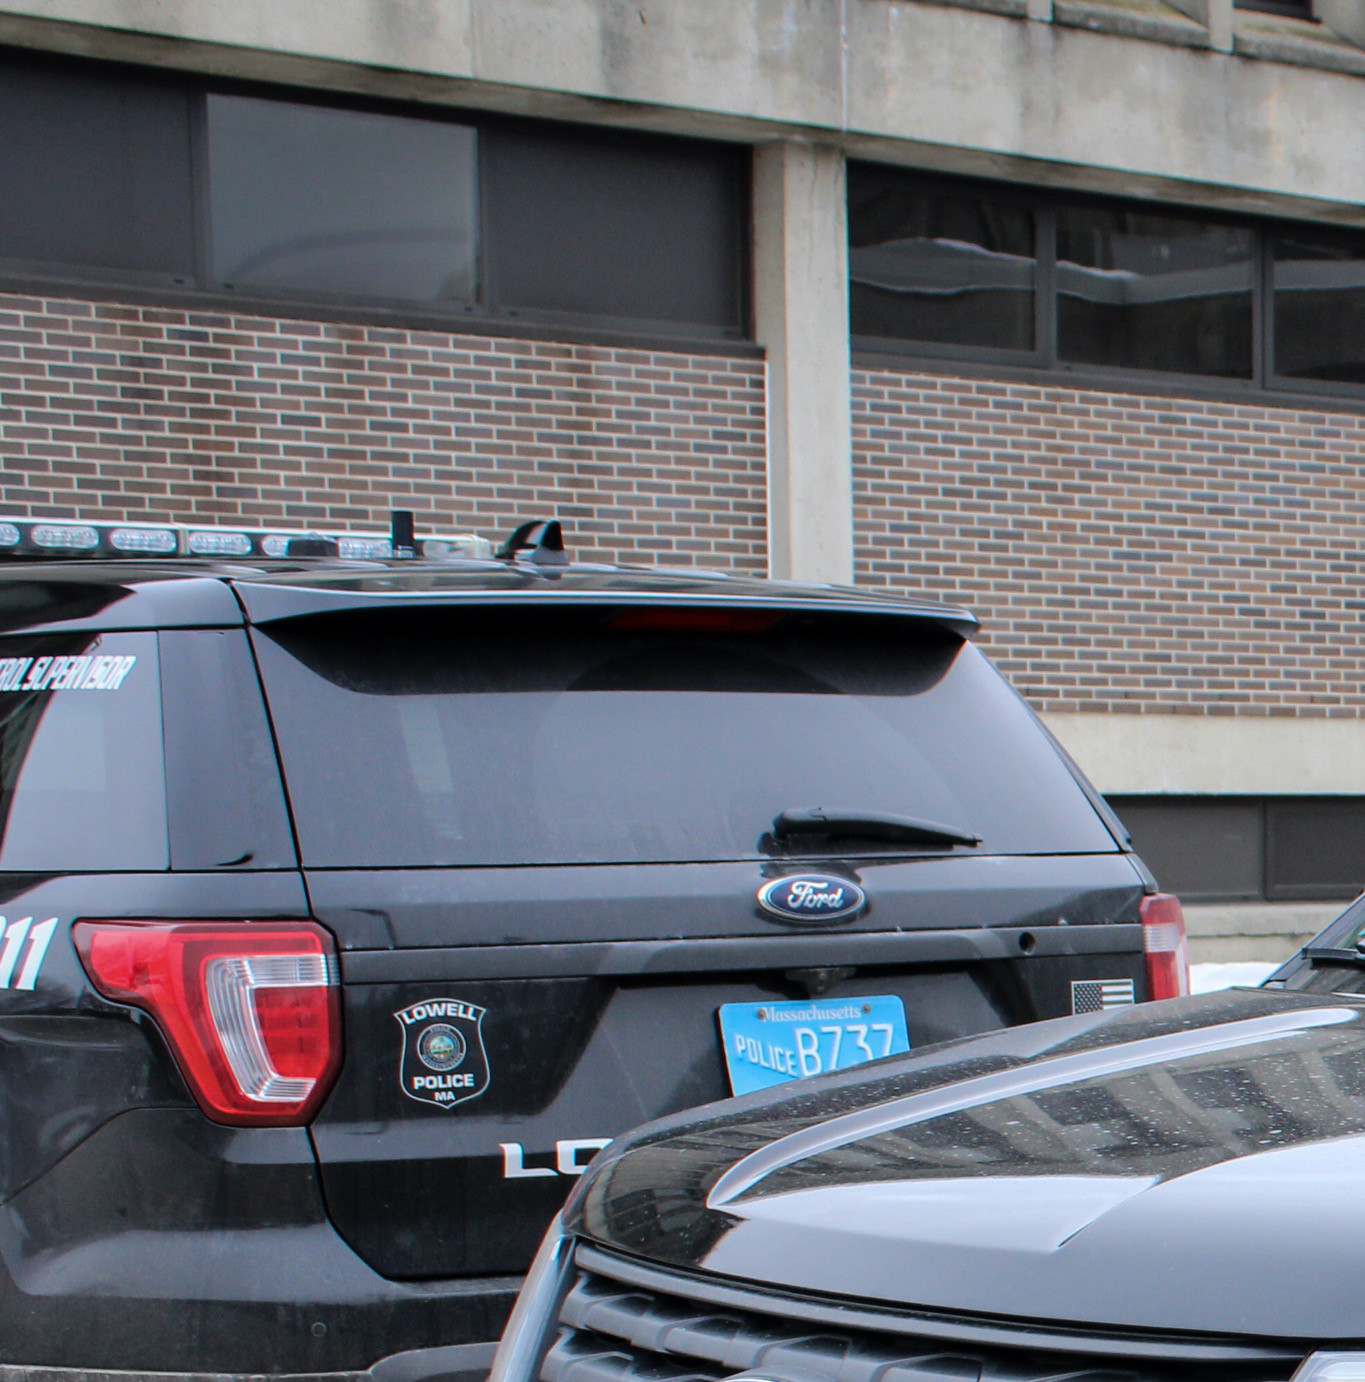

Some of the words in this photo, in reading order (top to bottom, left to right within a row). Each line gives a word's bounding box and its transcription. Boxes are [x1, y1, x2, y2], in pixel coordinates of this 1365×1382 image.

[0, 656, 35, 691] ROL
[20, 655, 138, 690] SUPERVISOR
[785, 880, 845, 909] Ford
[0, 915, 60, 991] 11
[401, 1002, 478, 1026] LOWELL
[762, 1004, 862, 1023] Massachusetts
[733, 1032, 798, 1077] POLICE
[794, 1022, 894, 1078] B737
[411, 1073, 475, 1090] POLICE
[433, 1091, 456, 1102] MA
